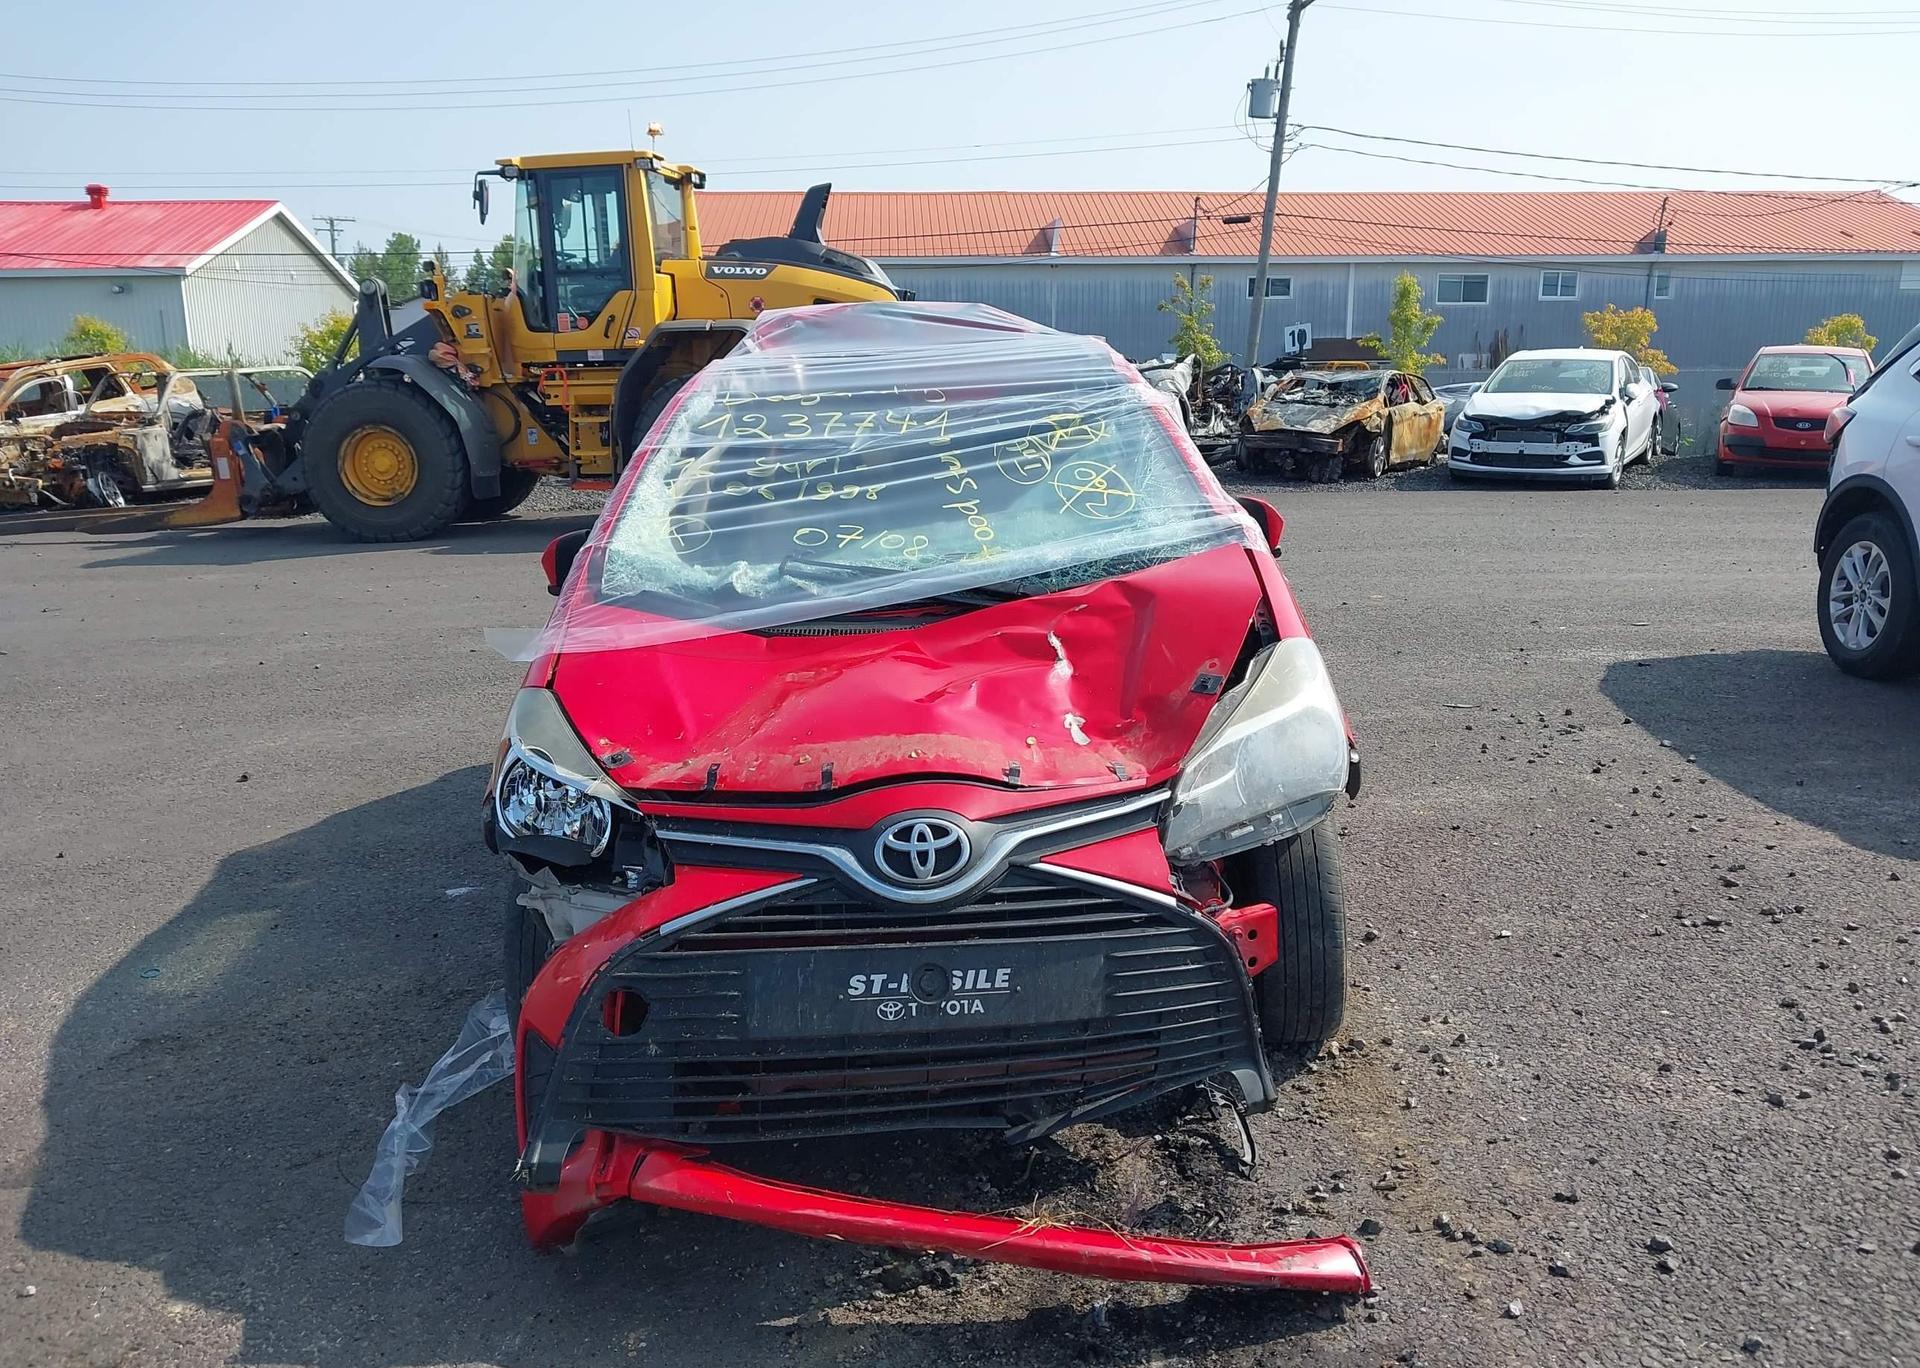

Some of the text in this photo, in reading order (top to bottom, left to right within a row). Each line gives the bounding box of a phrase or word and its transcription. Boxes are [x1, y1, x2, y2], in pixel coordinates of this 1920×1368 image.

[711, 266, 768, 275] VOLVO
[792, 524, 929, 559] 07/08
[847, 967, 1012, 997] ST-SILE
[907, 999, 985, 1018] TOTA
